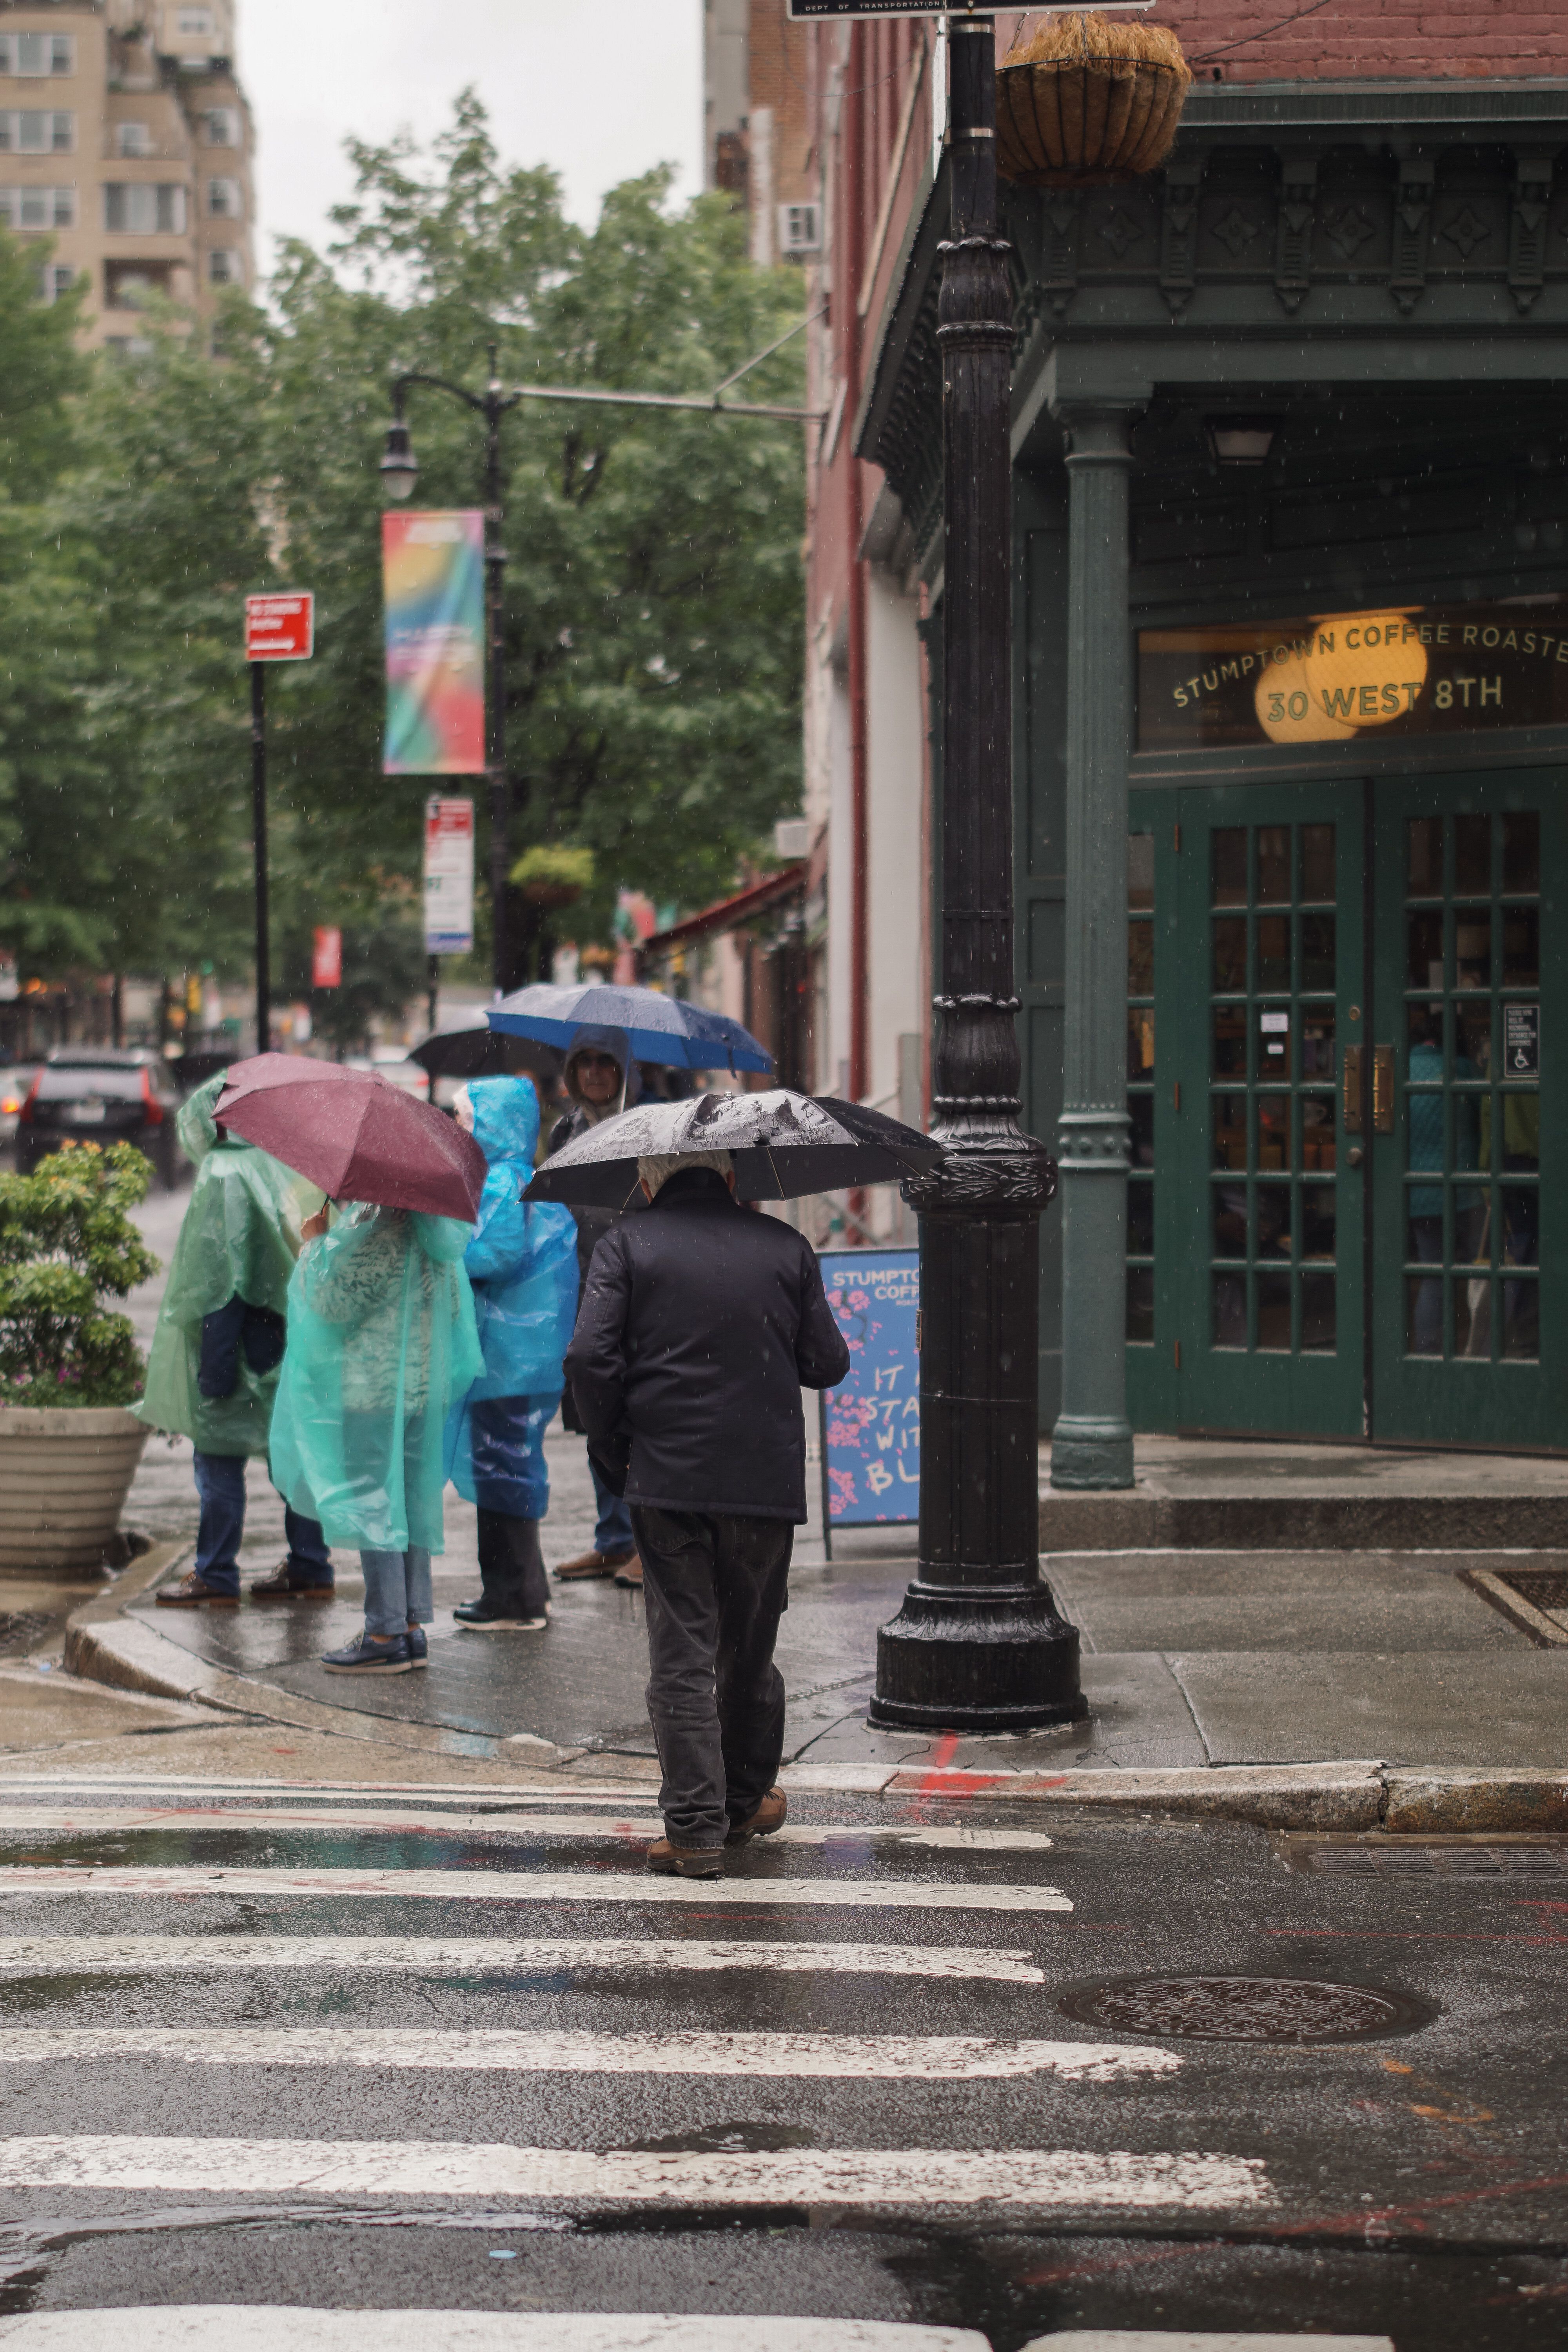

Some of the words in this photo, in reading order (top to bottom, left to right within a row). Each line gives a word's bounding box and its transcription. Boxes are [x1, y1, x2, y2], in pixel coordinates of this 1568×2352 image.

[1173, 632, 1335, 708] STUMPTOWN
[1346, 624, 1450, 650] COFFEE
[1463, 626, 1568, 664] ROASTE
[1267, 691, 1308, 722] 30
[1322, 682, 1422, 718] WEST
[1436, 676, 1501, 709] 8TH
[875, 1365, 904, 1391] IT
[866, 1396, 919, 1422] STA
